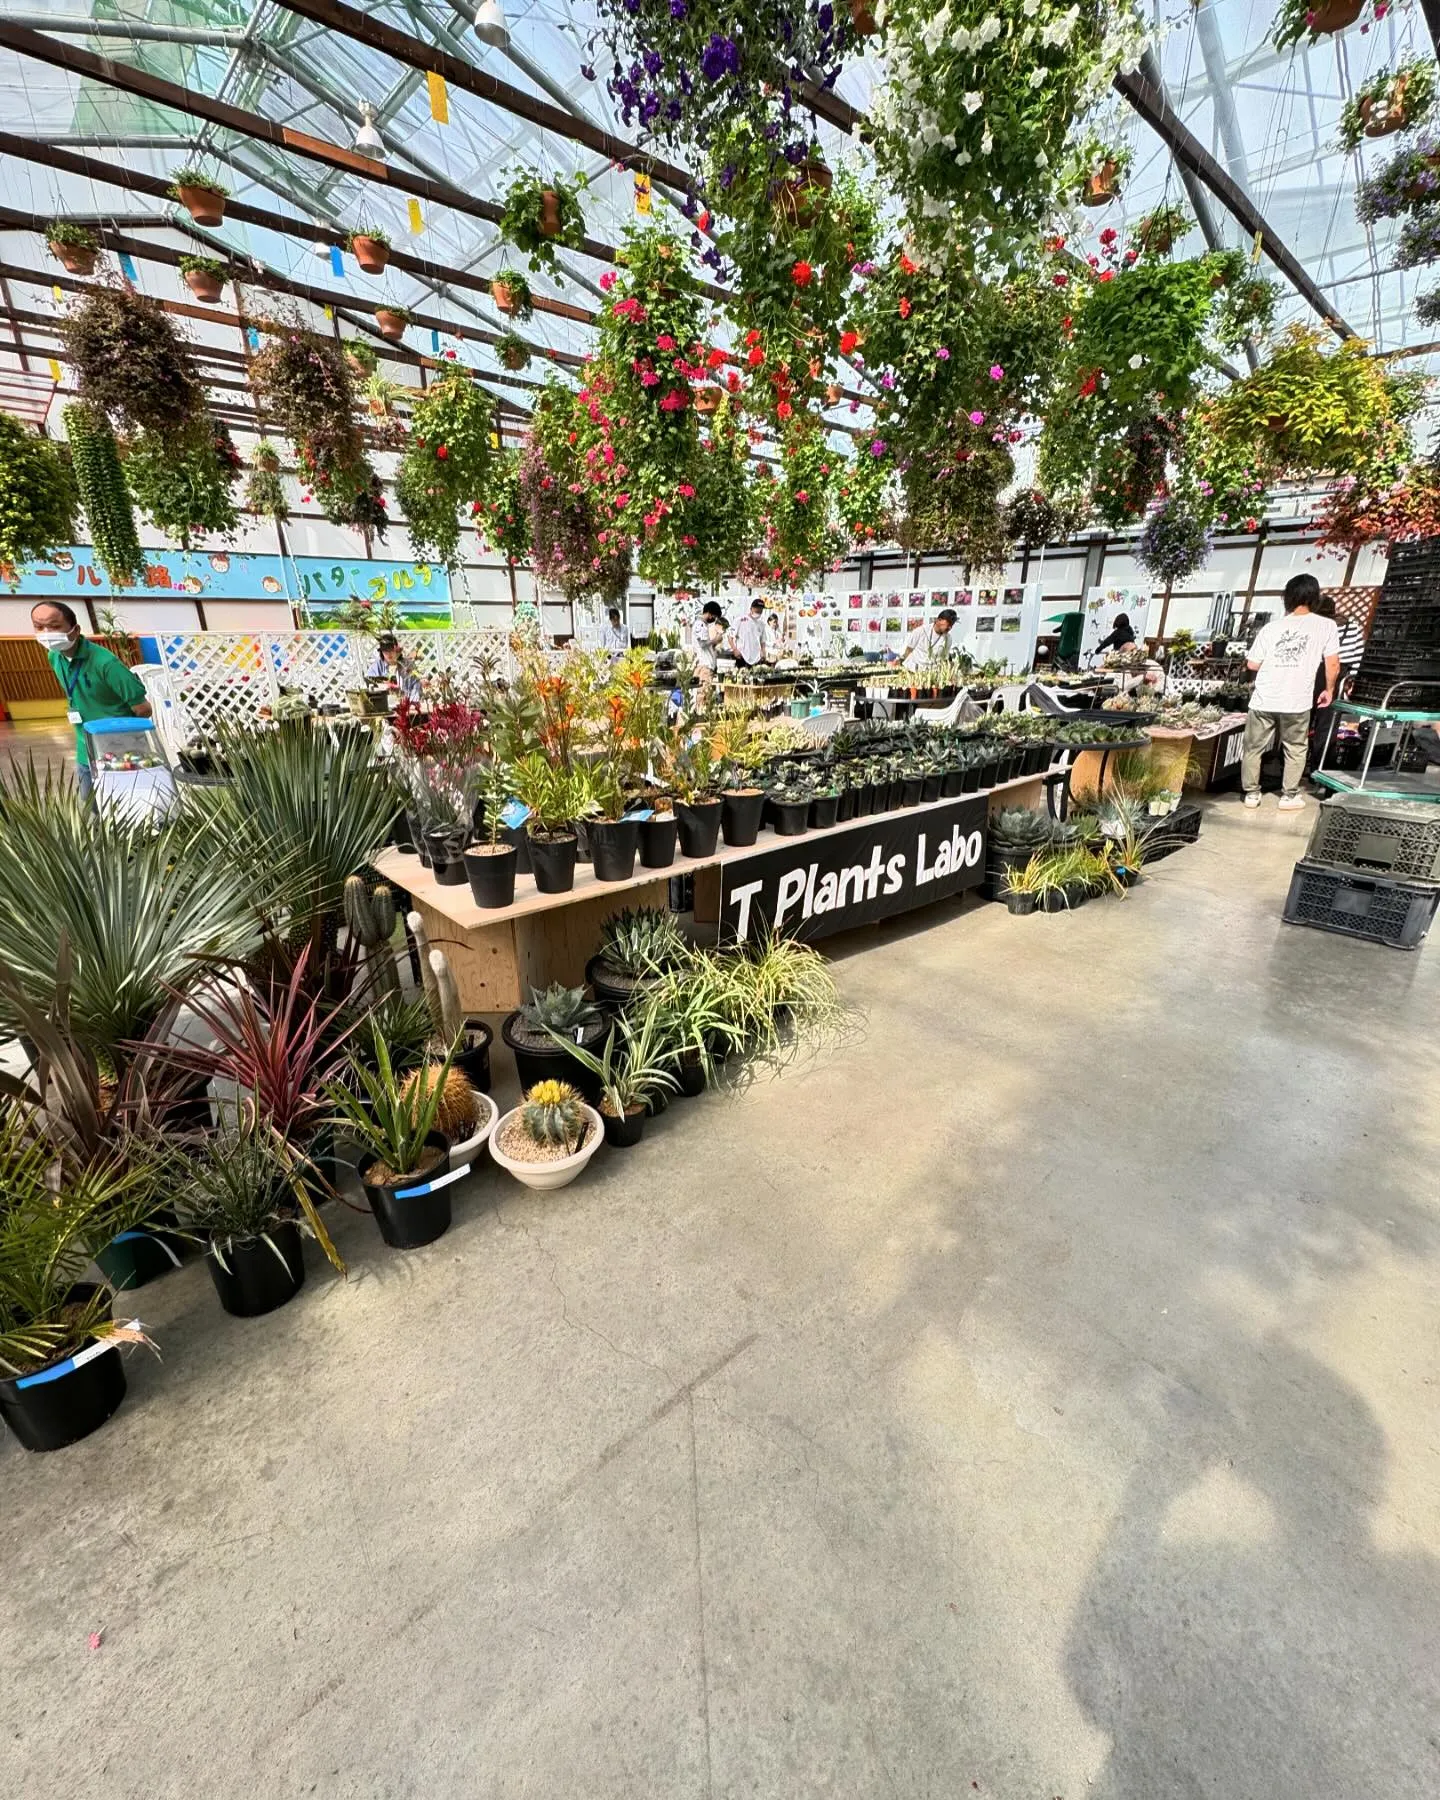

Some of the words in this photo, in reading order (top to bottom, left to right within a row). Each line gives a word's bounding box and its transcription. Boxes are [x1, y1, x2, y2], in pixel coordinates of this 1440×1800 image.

[730, 880, 762, 943] T
[774, 845, 906, 929] Plants
[916, 824, 982, 886] Labo
